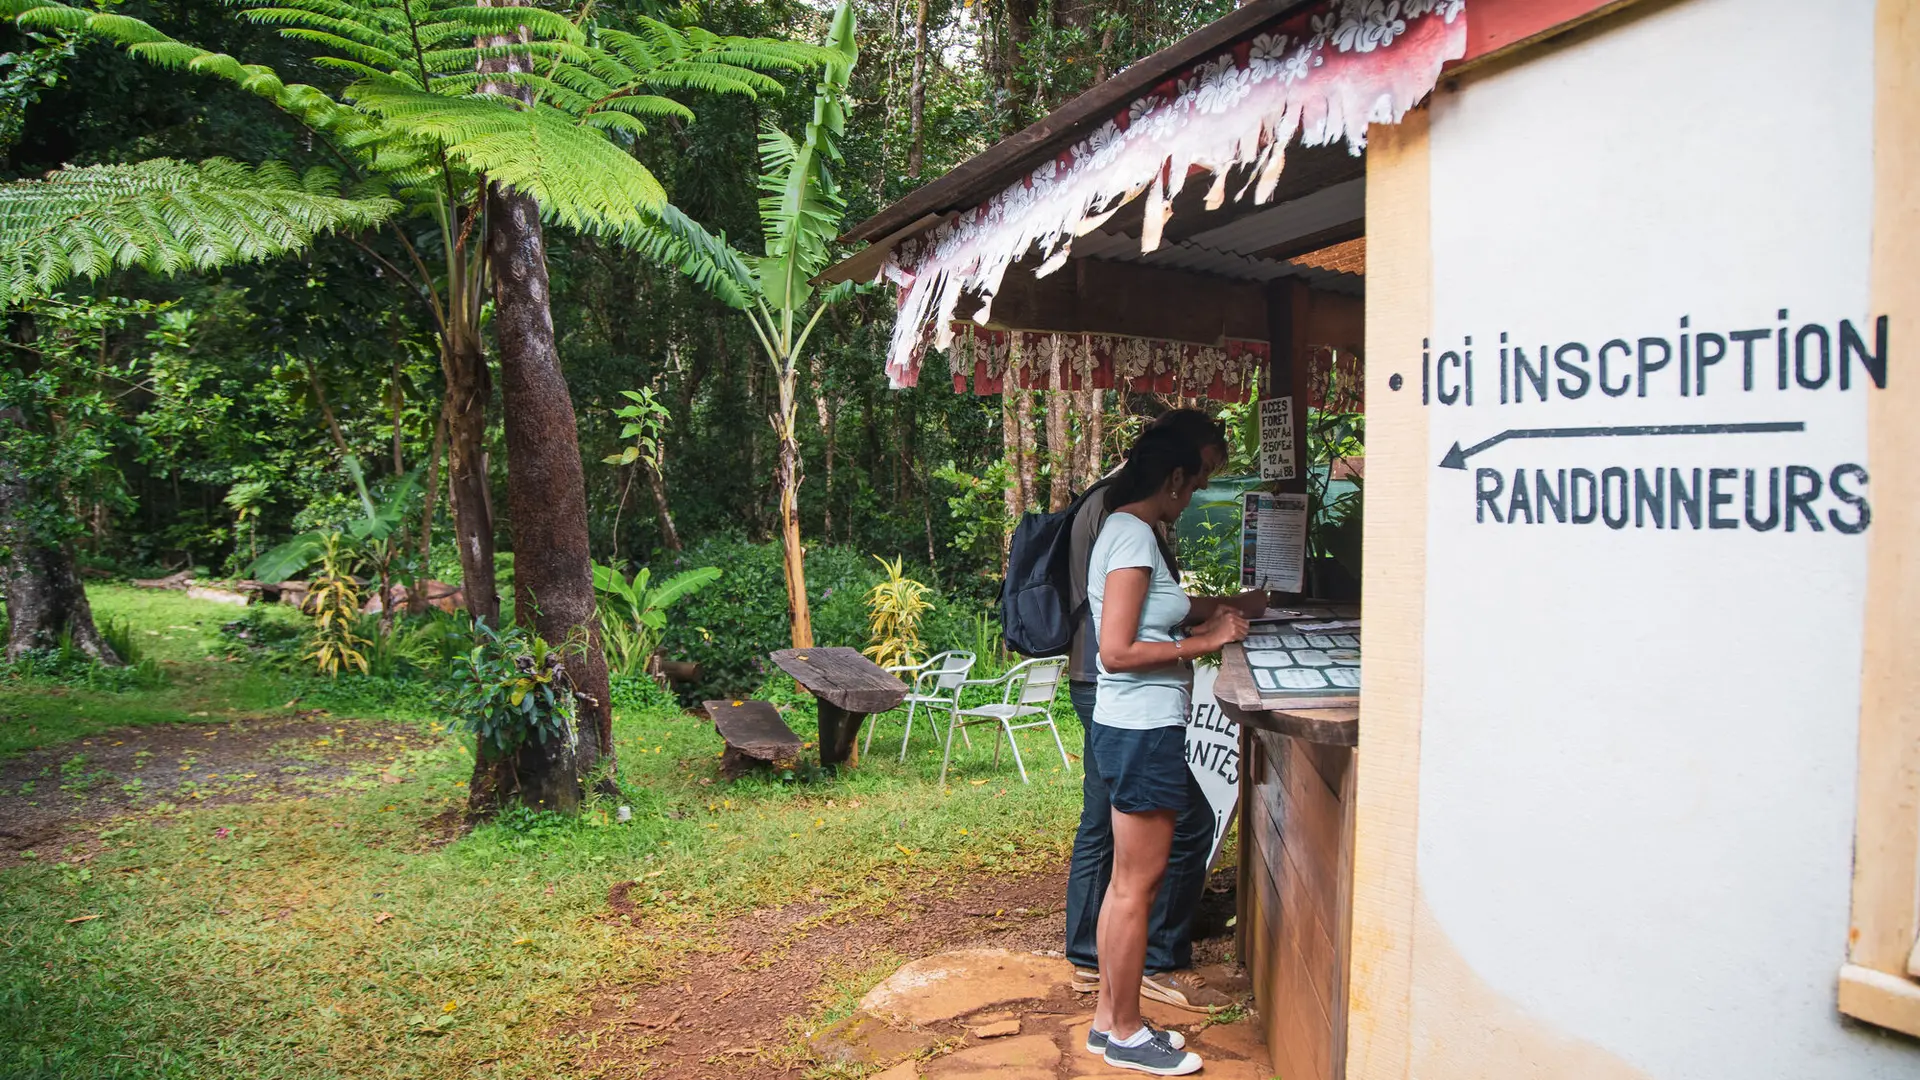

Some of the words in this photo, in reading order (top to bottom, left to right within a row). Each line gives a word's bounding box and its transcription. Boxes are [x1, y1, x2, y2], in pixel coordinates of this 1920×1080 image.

[1262, 400, 1288, 414] ACCES
[1262, 414, 1288, 427] FORET
[1476, 463, 1872, 535] RANDONNEURS
